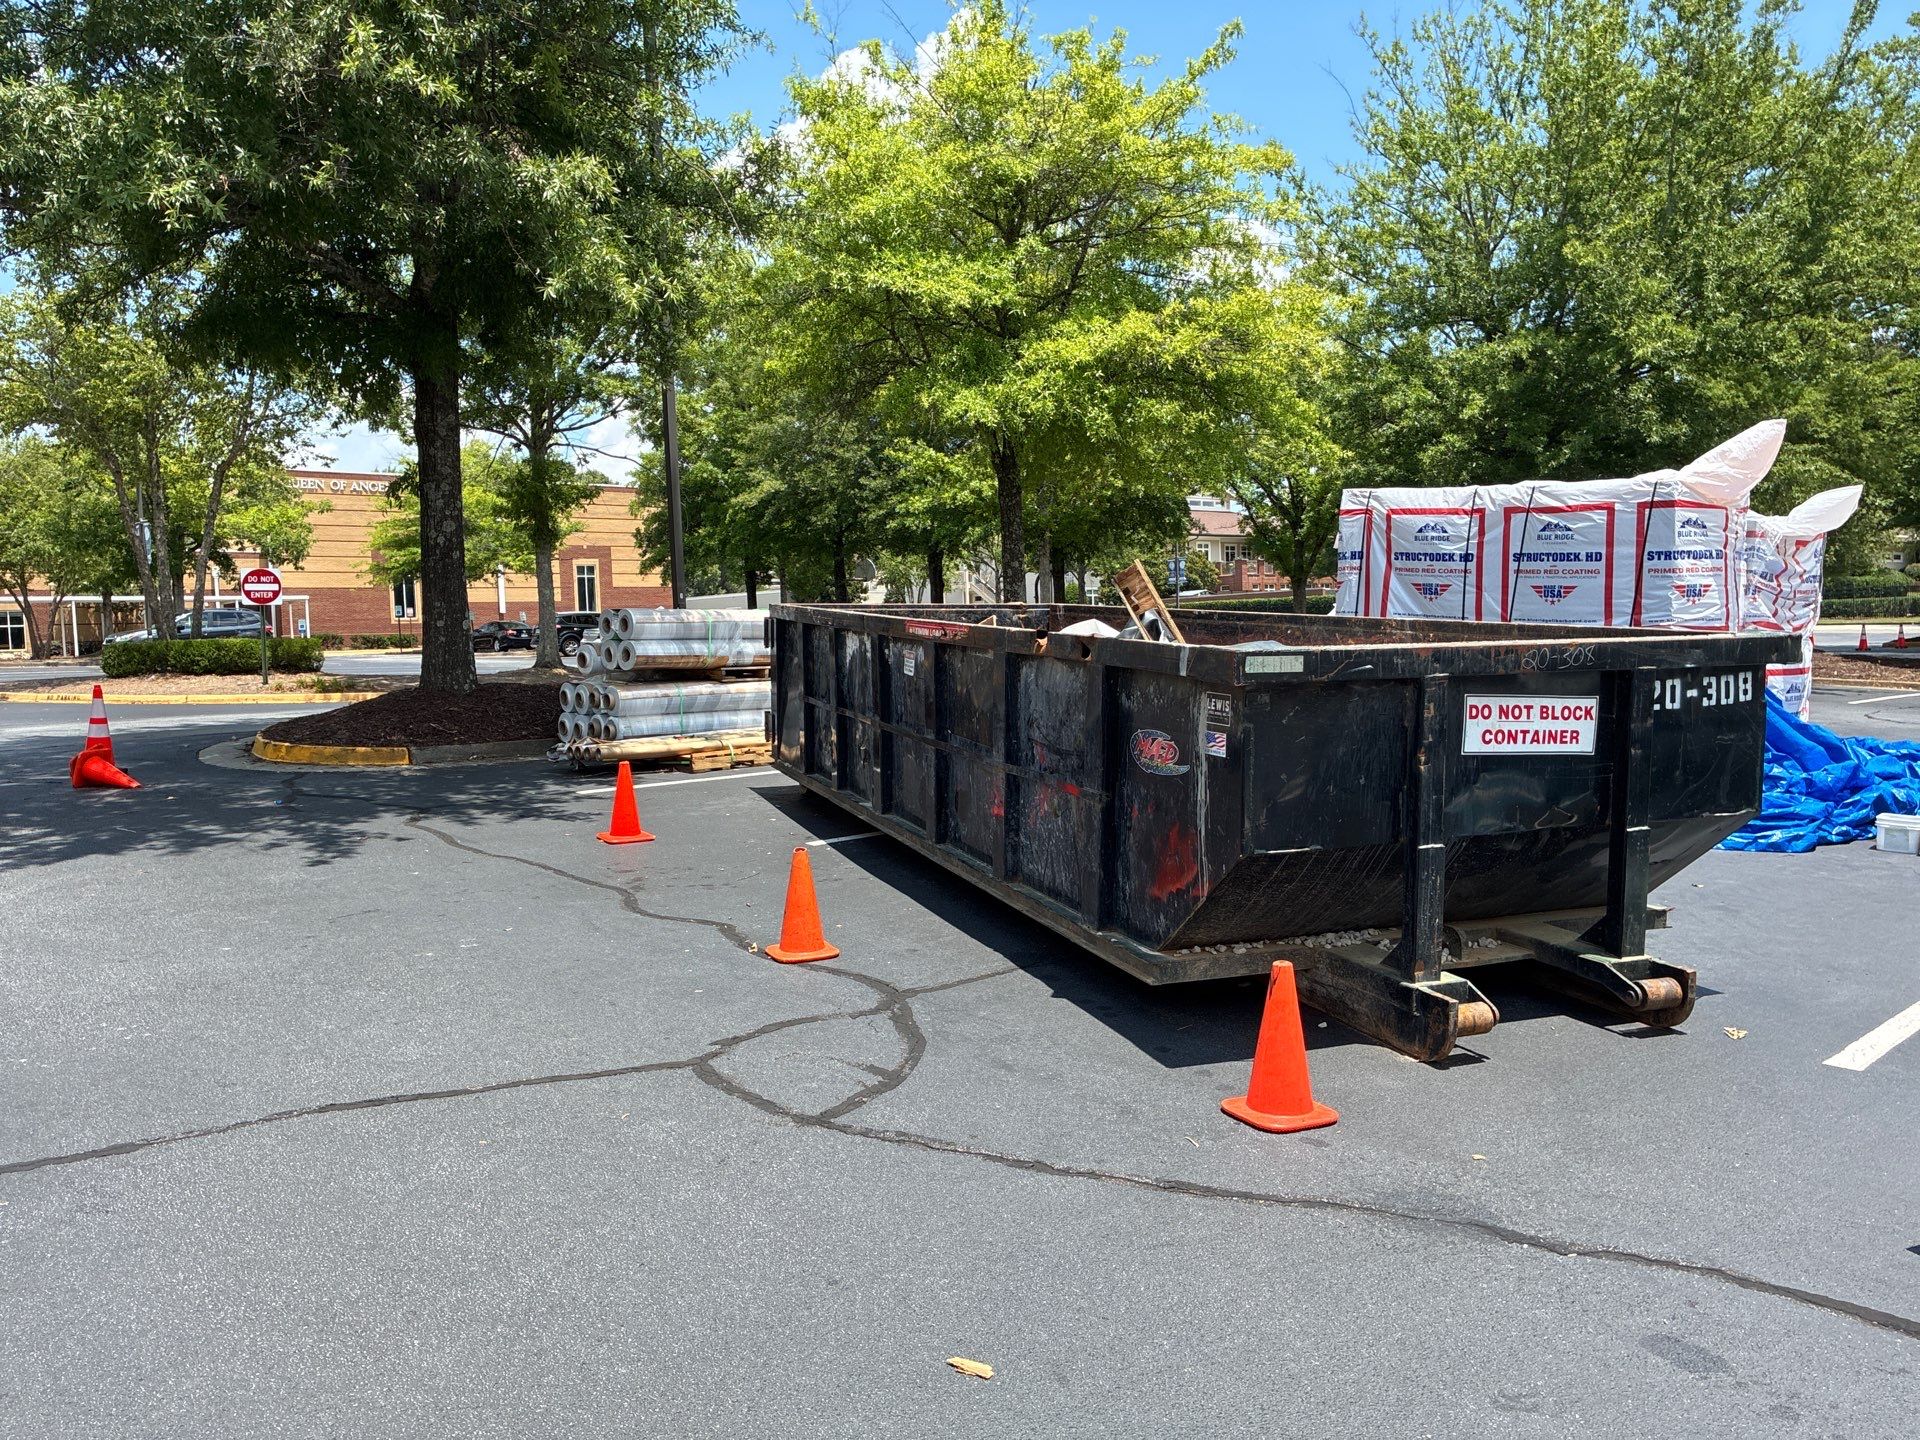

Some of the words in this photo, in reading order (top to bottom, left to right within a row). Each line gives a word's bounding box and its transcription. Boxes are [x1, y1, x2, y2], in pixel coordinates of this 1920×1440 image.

[289, 480, 324, 489] UEEN
[330, 480, 346, 490] OF
[350, 481, 389, 491] ANGE
[1394, 552, 1455, 562] STRUCTODEK
[1459, 552, 1474, 563] HD
[1512, 552, 1582, 562] STRUCTODEK
[1585, 552, 1603, 562] HD
[1647, 550, 1714, 561] STRUCTODEK
[1422, 588, 1439, 596] USA
[1543, 590, 1563, 598] USA
[1686, 589, 1702, 598] USA
[1207, 698, 1230, 712] LEWIS
[1468, 704, 1492, 720] DO
[1497, 704, 1534, 720] NOT
[1539, 705, 1595, 721] BLOCK
[1481, 729, 1580, 745] CONTAINER
